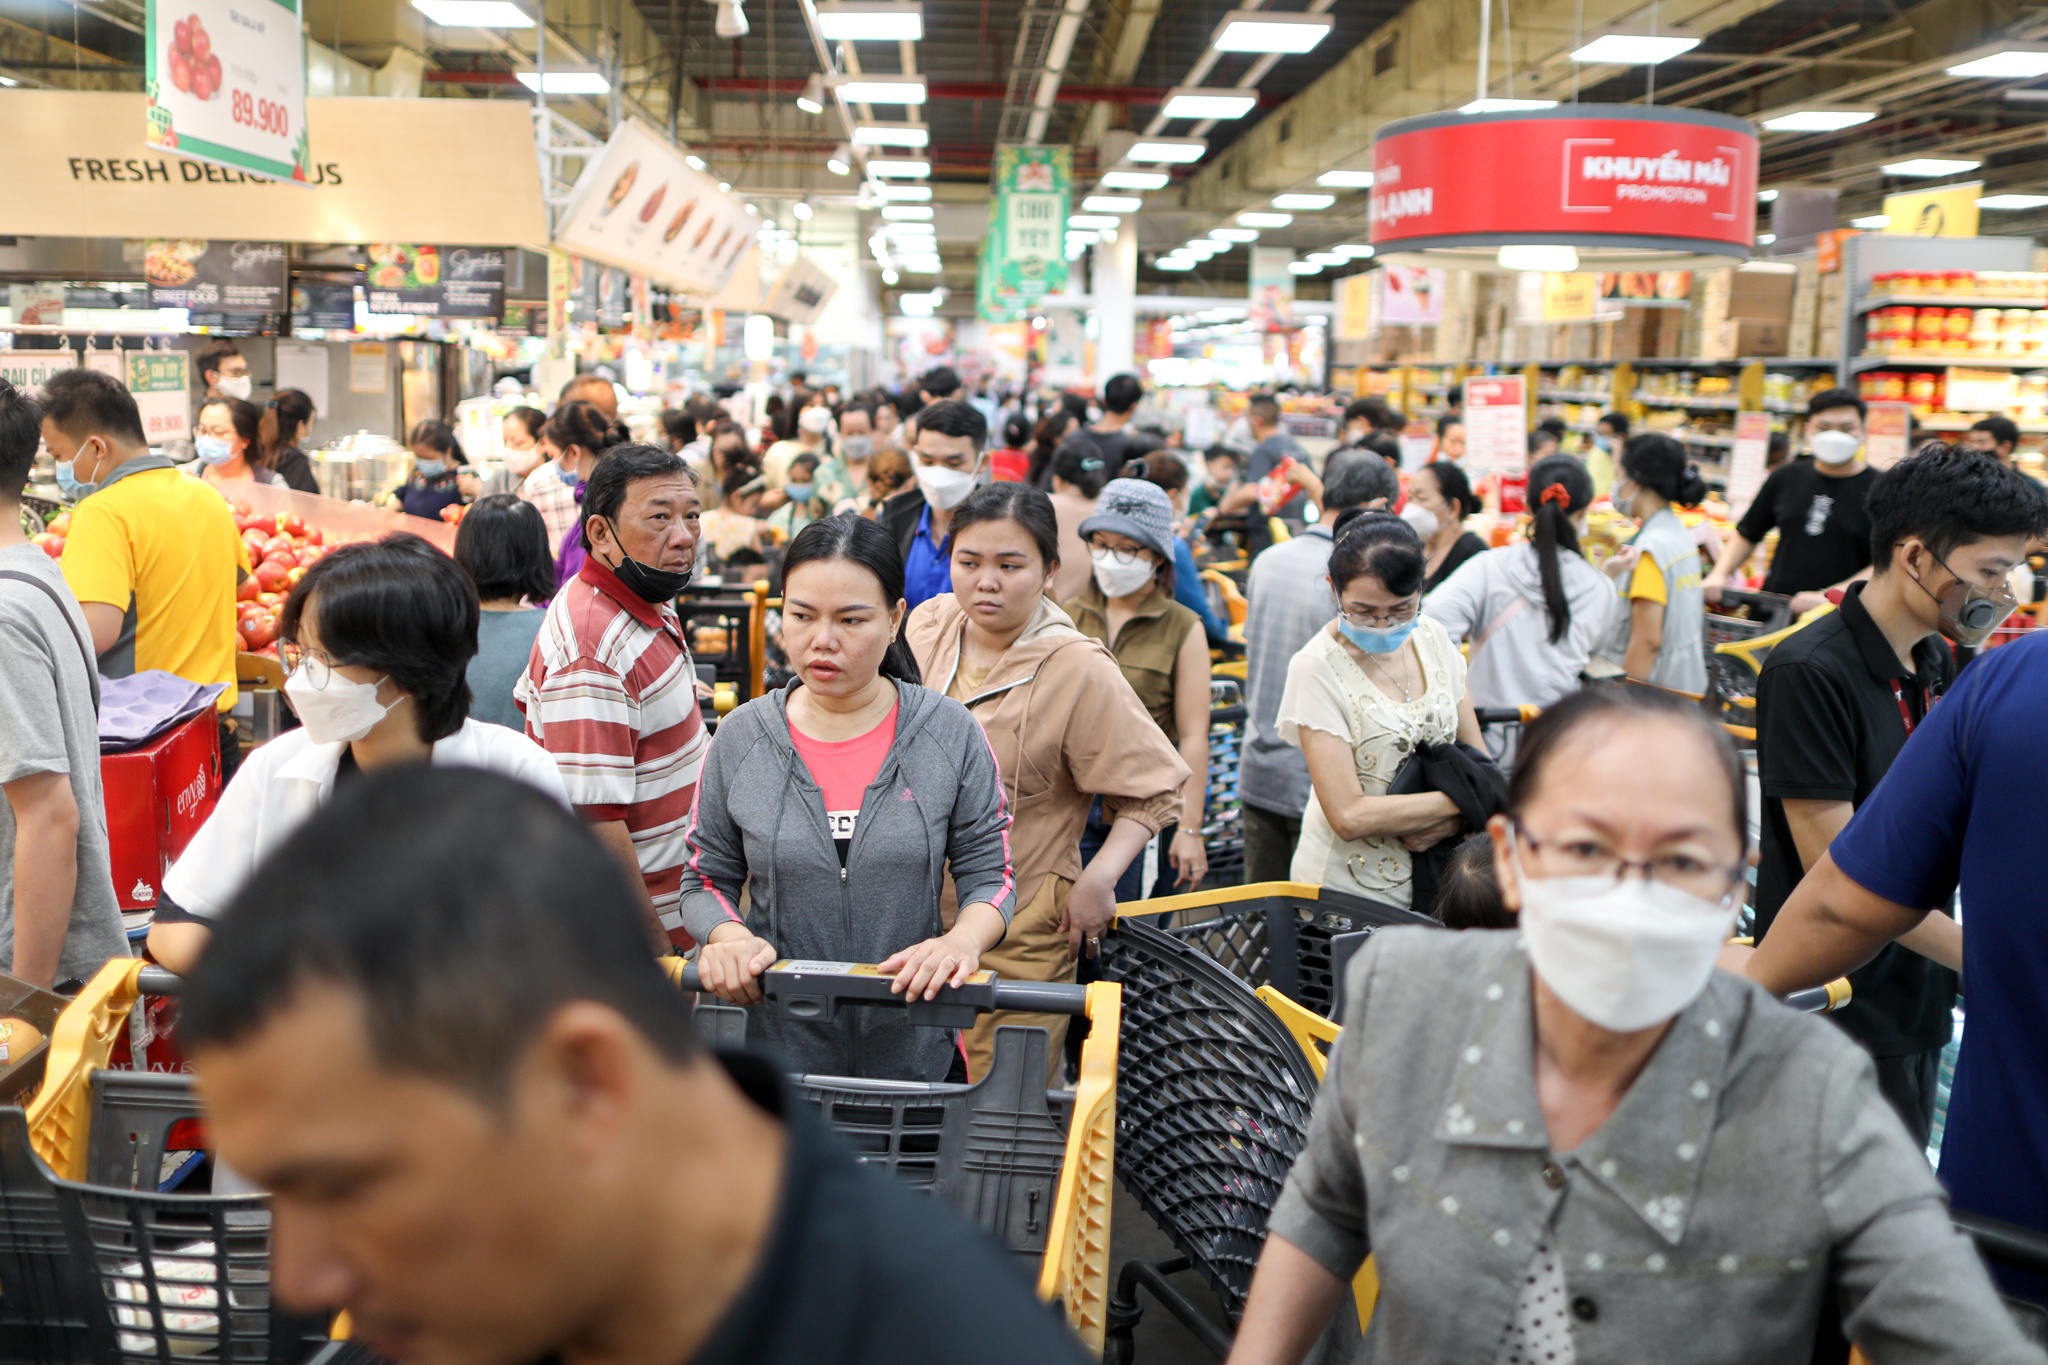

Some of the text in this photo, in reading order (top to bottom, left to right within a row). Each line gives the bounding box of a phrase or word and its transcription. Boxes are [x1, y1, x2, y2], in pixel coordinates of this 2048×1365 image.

[232, 88, 289, 138] 89.900
[68, 158, 170, 182] FRESH
[1582, 149, 1692, 182] KHUYẾN
[1616, 184, 1708, 204] PROMOTION
